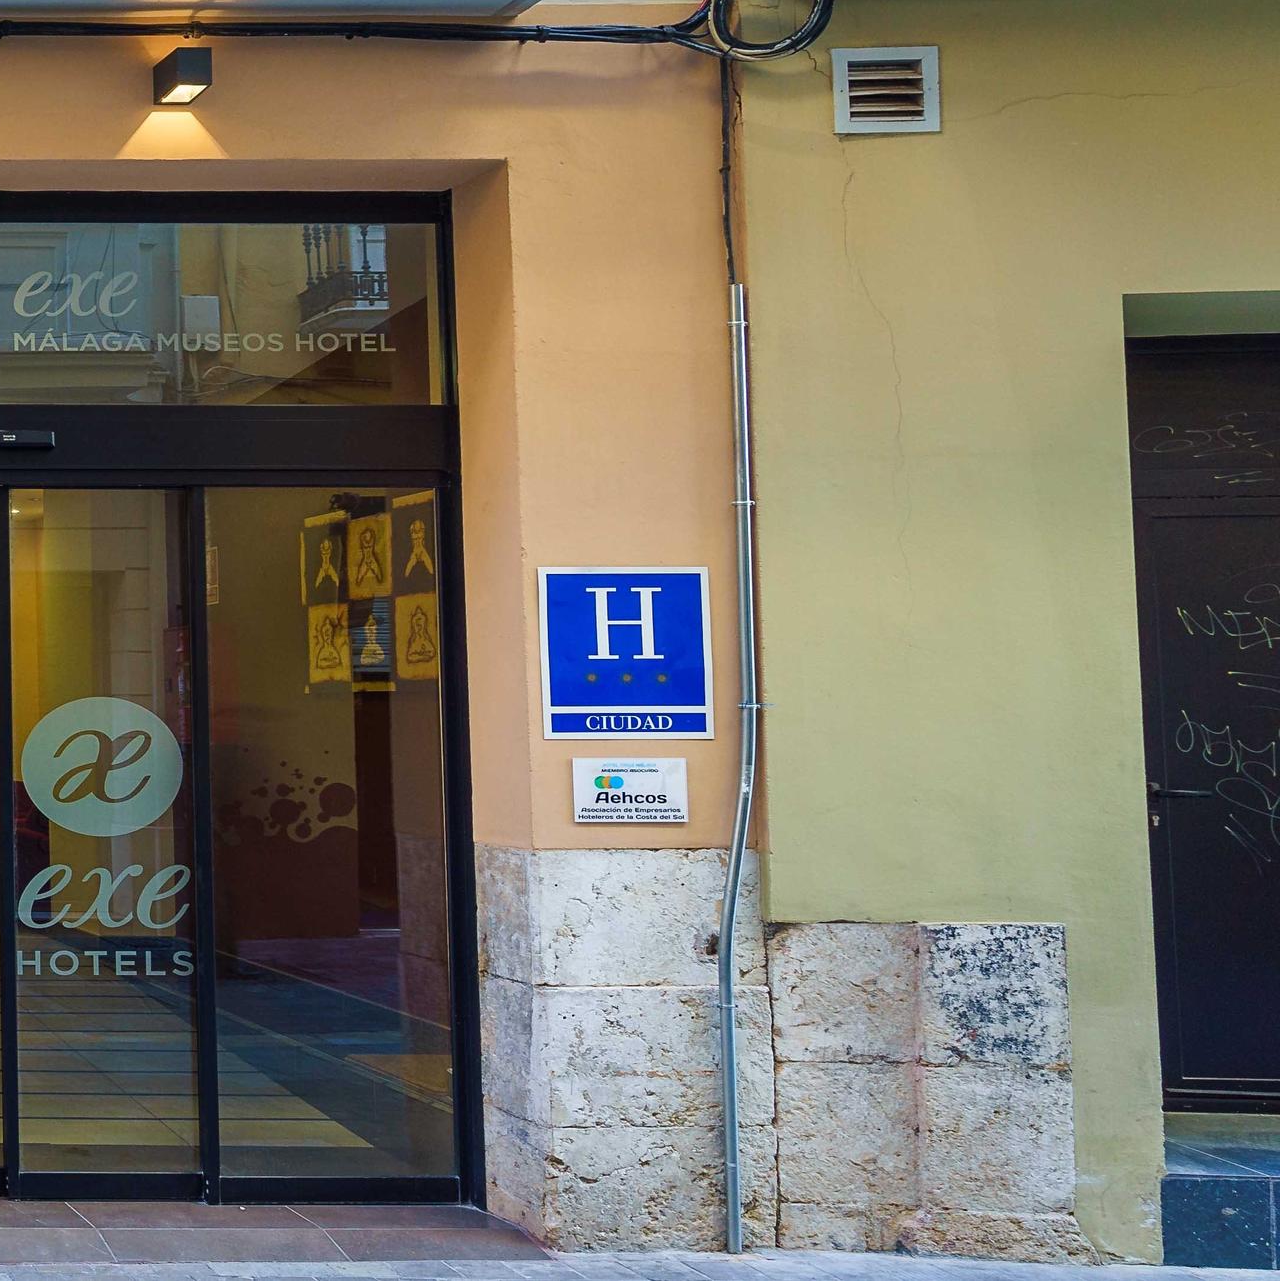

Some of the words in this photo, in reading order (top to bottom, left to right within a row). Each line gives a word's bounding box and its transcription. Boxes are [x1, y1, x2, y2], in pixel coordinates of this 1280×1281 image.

[12, 269, 139, 318] exe
[12, 327, 148, 353] MÁLAGA
[157, 331, 285, 354] MUSEOS
[295, 331, 397, 353] HOTEL
[585, 586, 665, 660] H
[585, 714, 674, 731] CIUDAD
[581, 806, 622, 814] Asociación
[634, 807, 681, 815] Empresarios
[595, 791, 668, 804] Aehcos
[17, 863, 192, 930] exe
[16, 949, 195, 977] HOTELS
